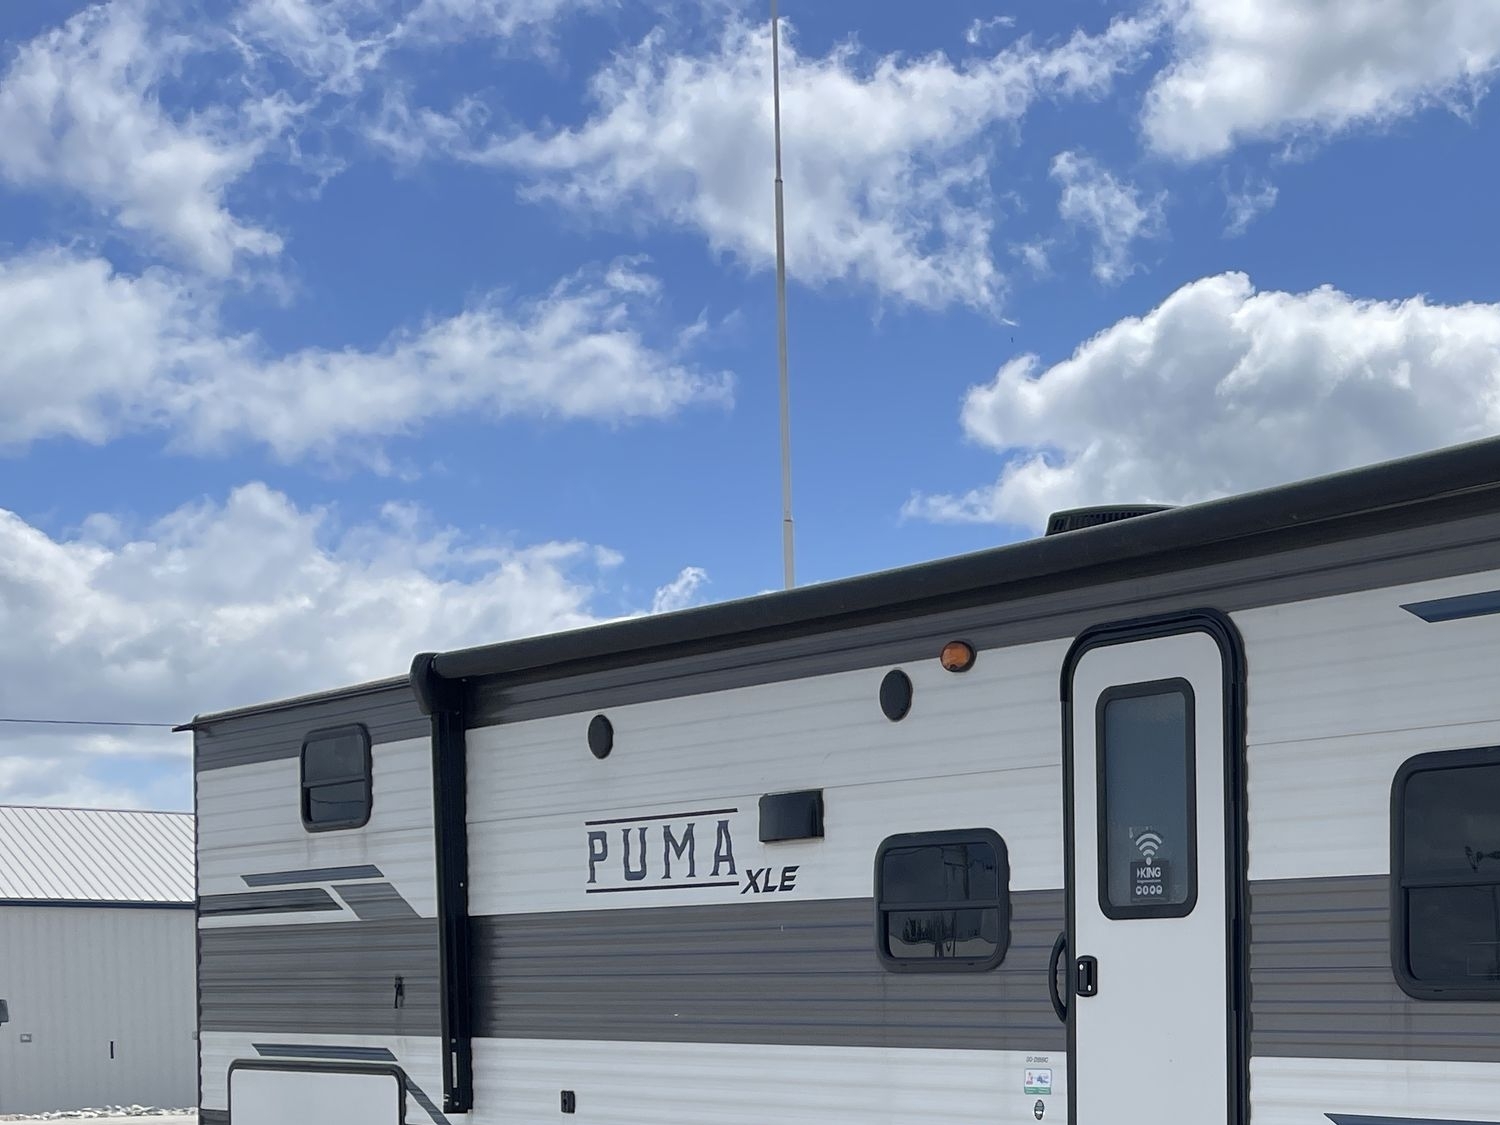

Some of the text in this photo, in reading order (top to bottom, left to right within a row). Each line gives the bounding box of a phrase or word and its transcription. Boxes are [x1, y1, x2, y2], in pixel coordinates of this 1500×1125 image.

[586, 819, 800, 895] PUMA XLE
[1140, 866, 1162, 879] KING
